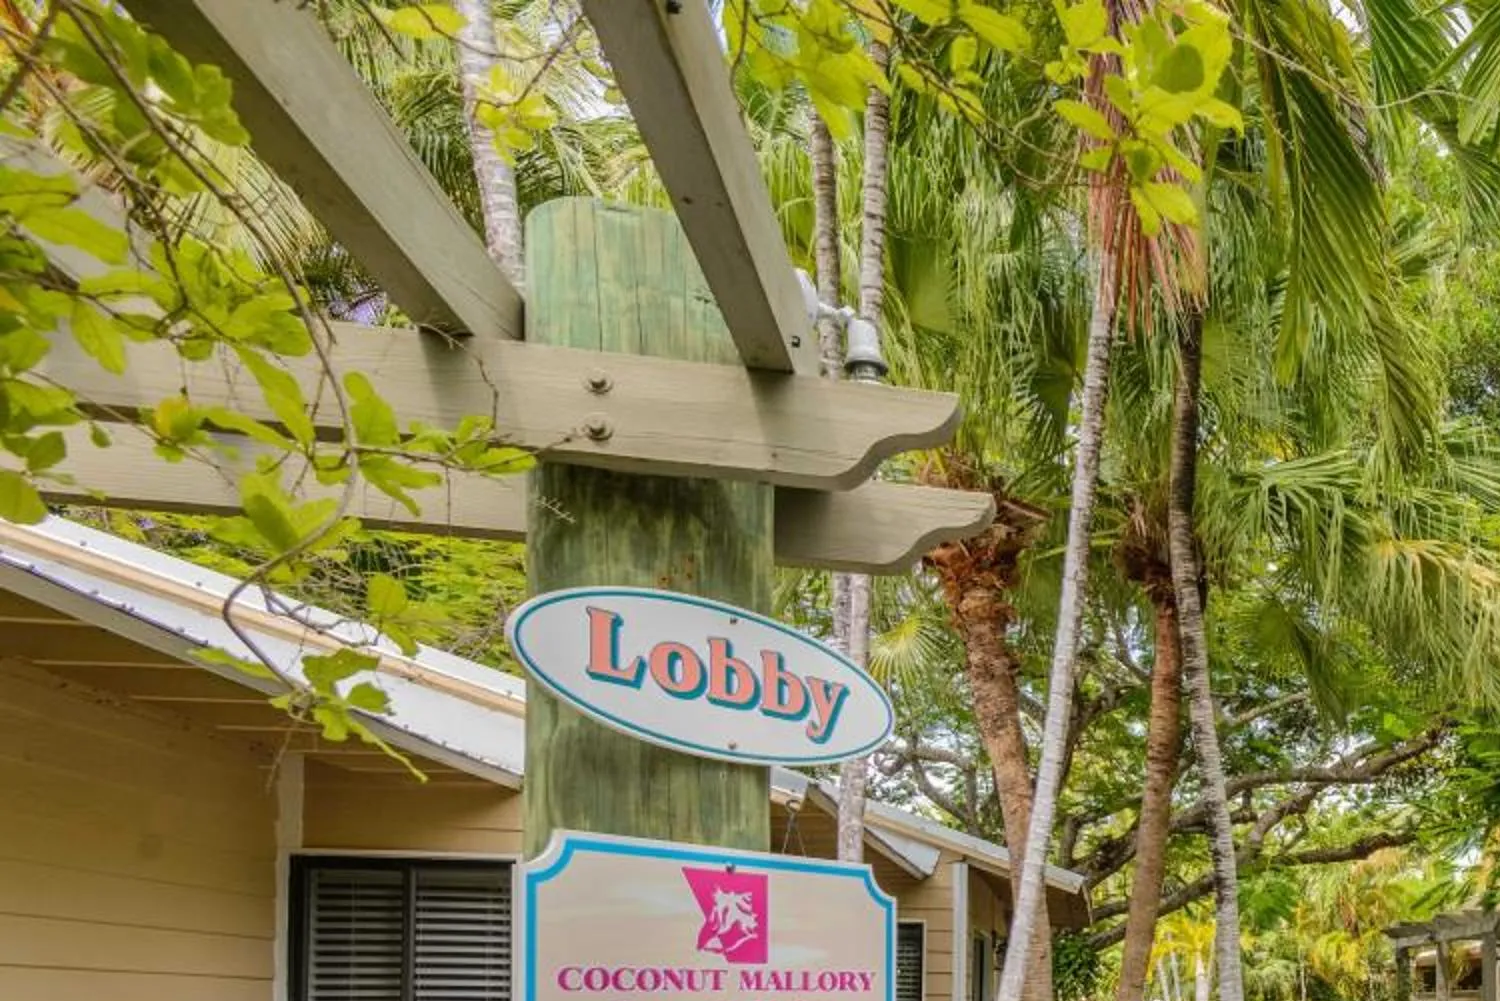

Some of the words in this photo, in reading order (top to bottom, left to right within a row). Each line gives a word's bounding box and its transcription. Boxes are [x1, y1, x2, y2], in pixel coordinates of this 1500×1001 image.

[586, 606, 850, 745] Lobby
[557, 966, 728, 992] COCONUT
[739, 970, 876, 992] MALLORY
